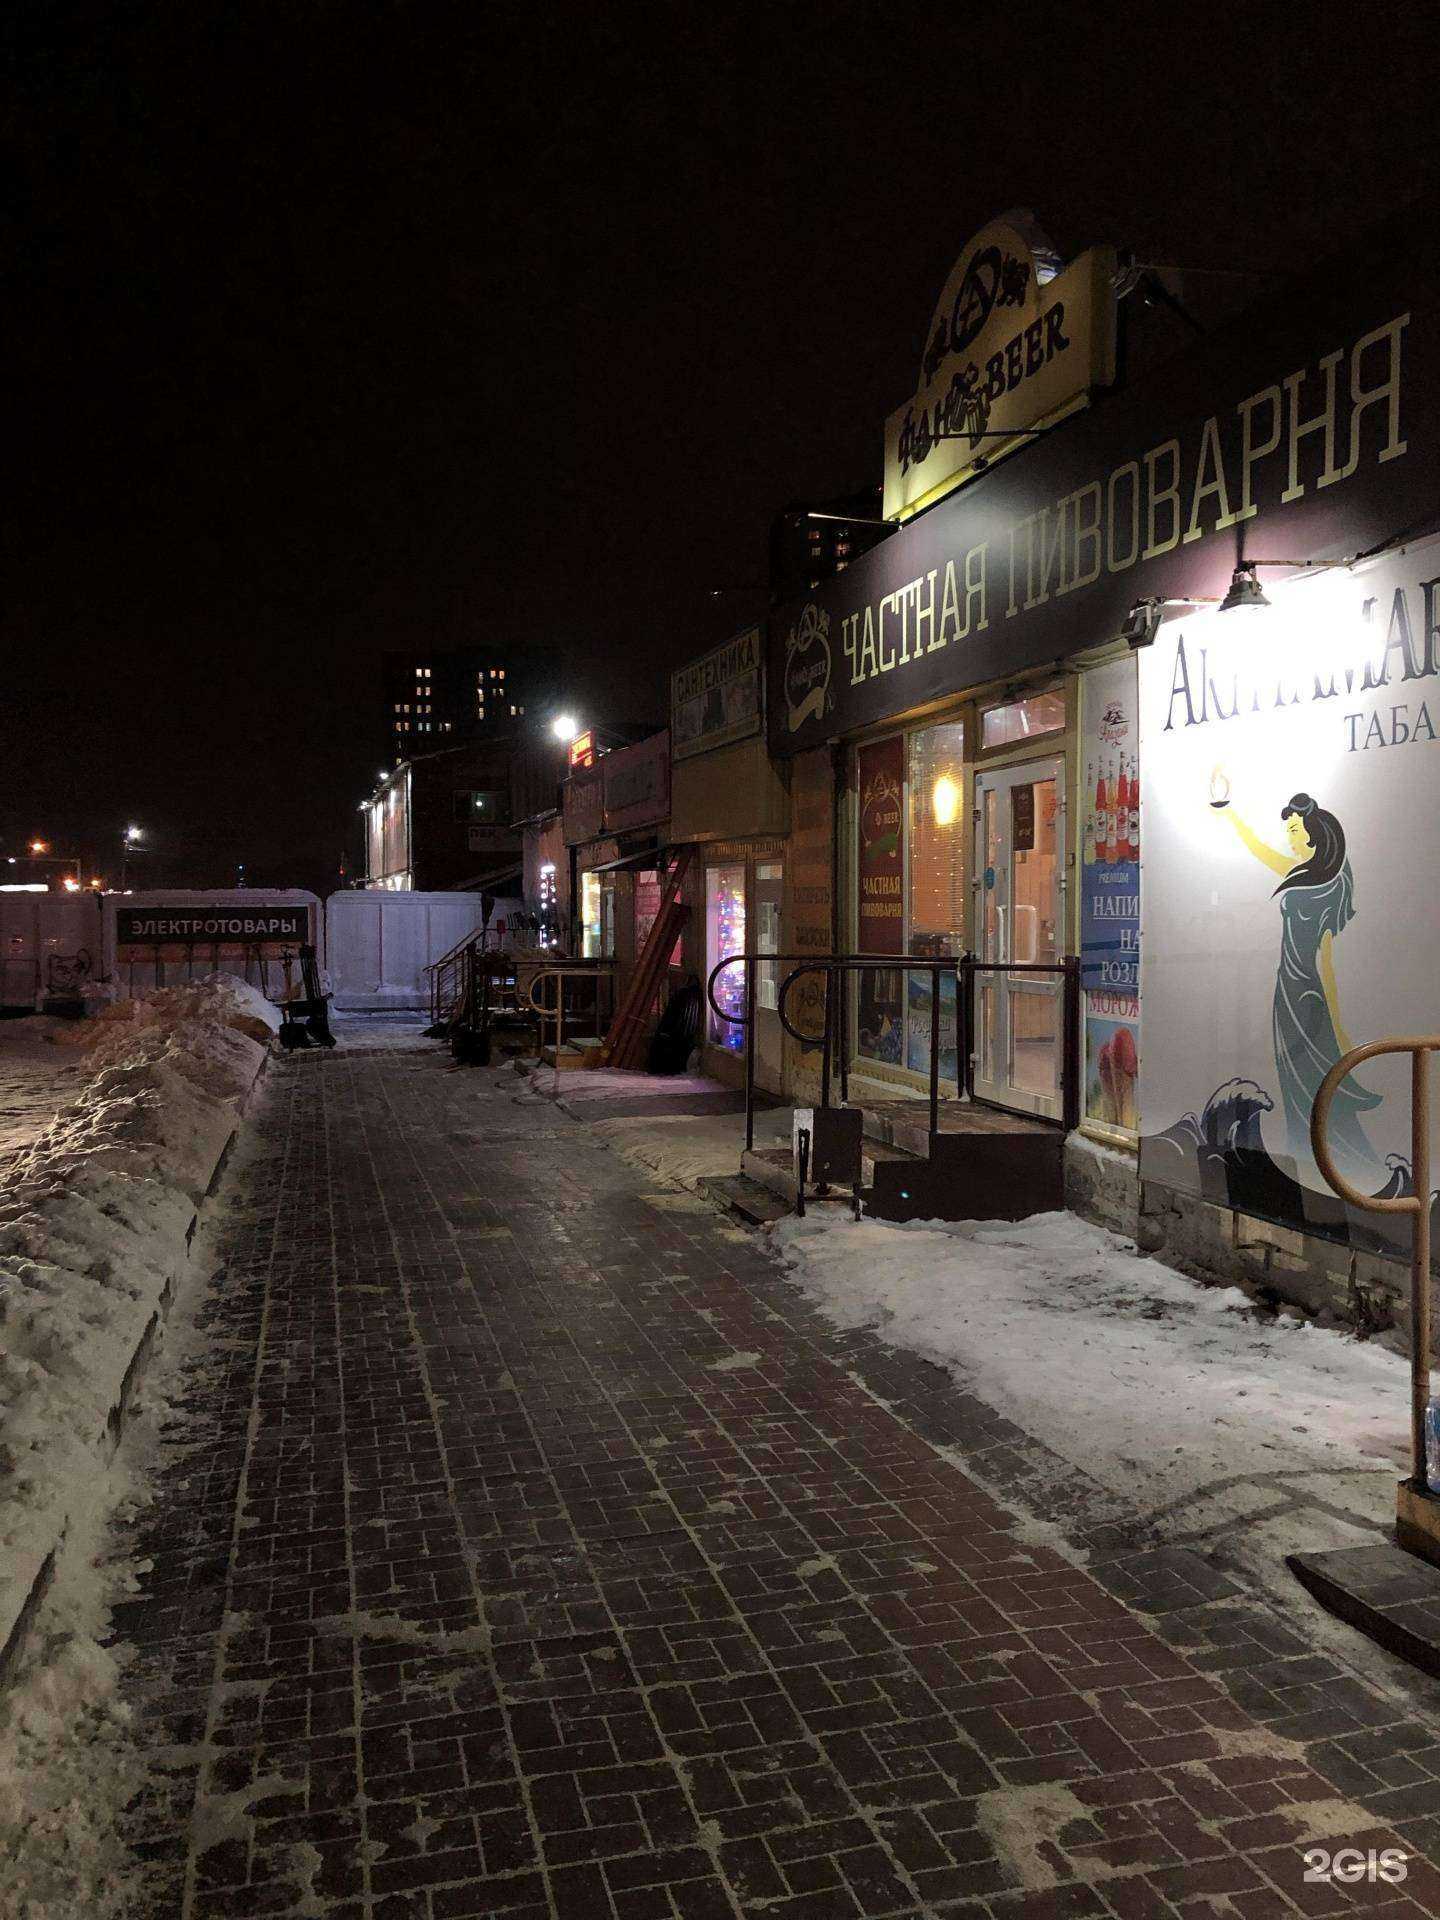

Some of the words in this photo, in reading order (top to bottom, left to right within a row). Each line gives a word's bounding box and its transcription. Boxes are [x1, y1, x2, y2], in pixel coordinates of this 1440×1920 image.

[986, 301, 1070, 401] BEER
[841, 541, 989, 686] ЧАСТНАЯ
[1006, 312, 1411, 620] ПИВОВАРНЯ
[1344, 701, 1440, 751] ТАБА
[862, 875, 901, 897] ЧАСТНАЯ
[861, 901, 903, 919] ПИВОВАРНЯ
[1092, 896, 1139, 917] НАПИ
[130, 918, 297, 936] ЭЛЕКТРОТОВАРЫ
